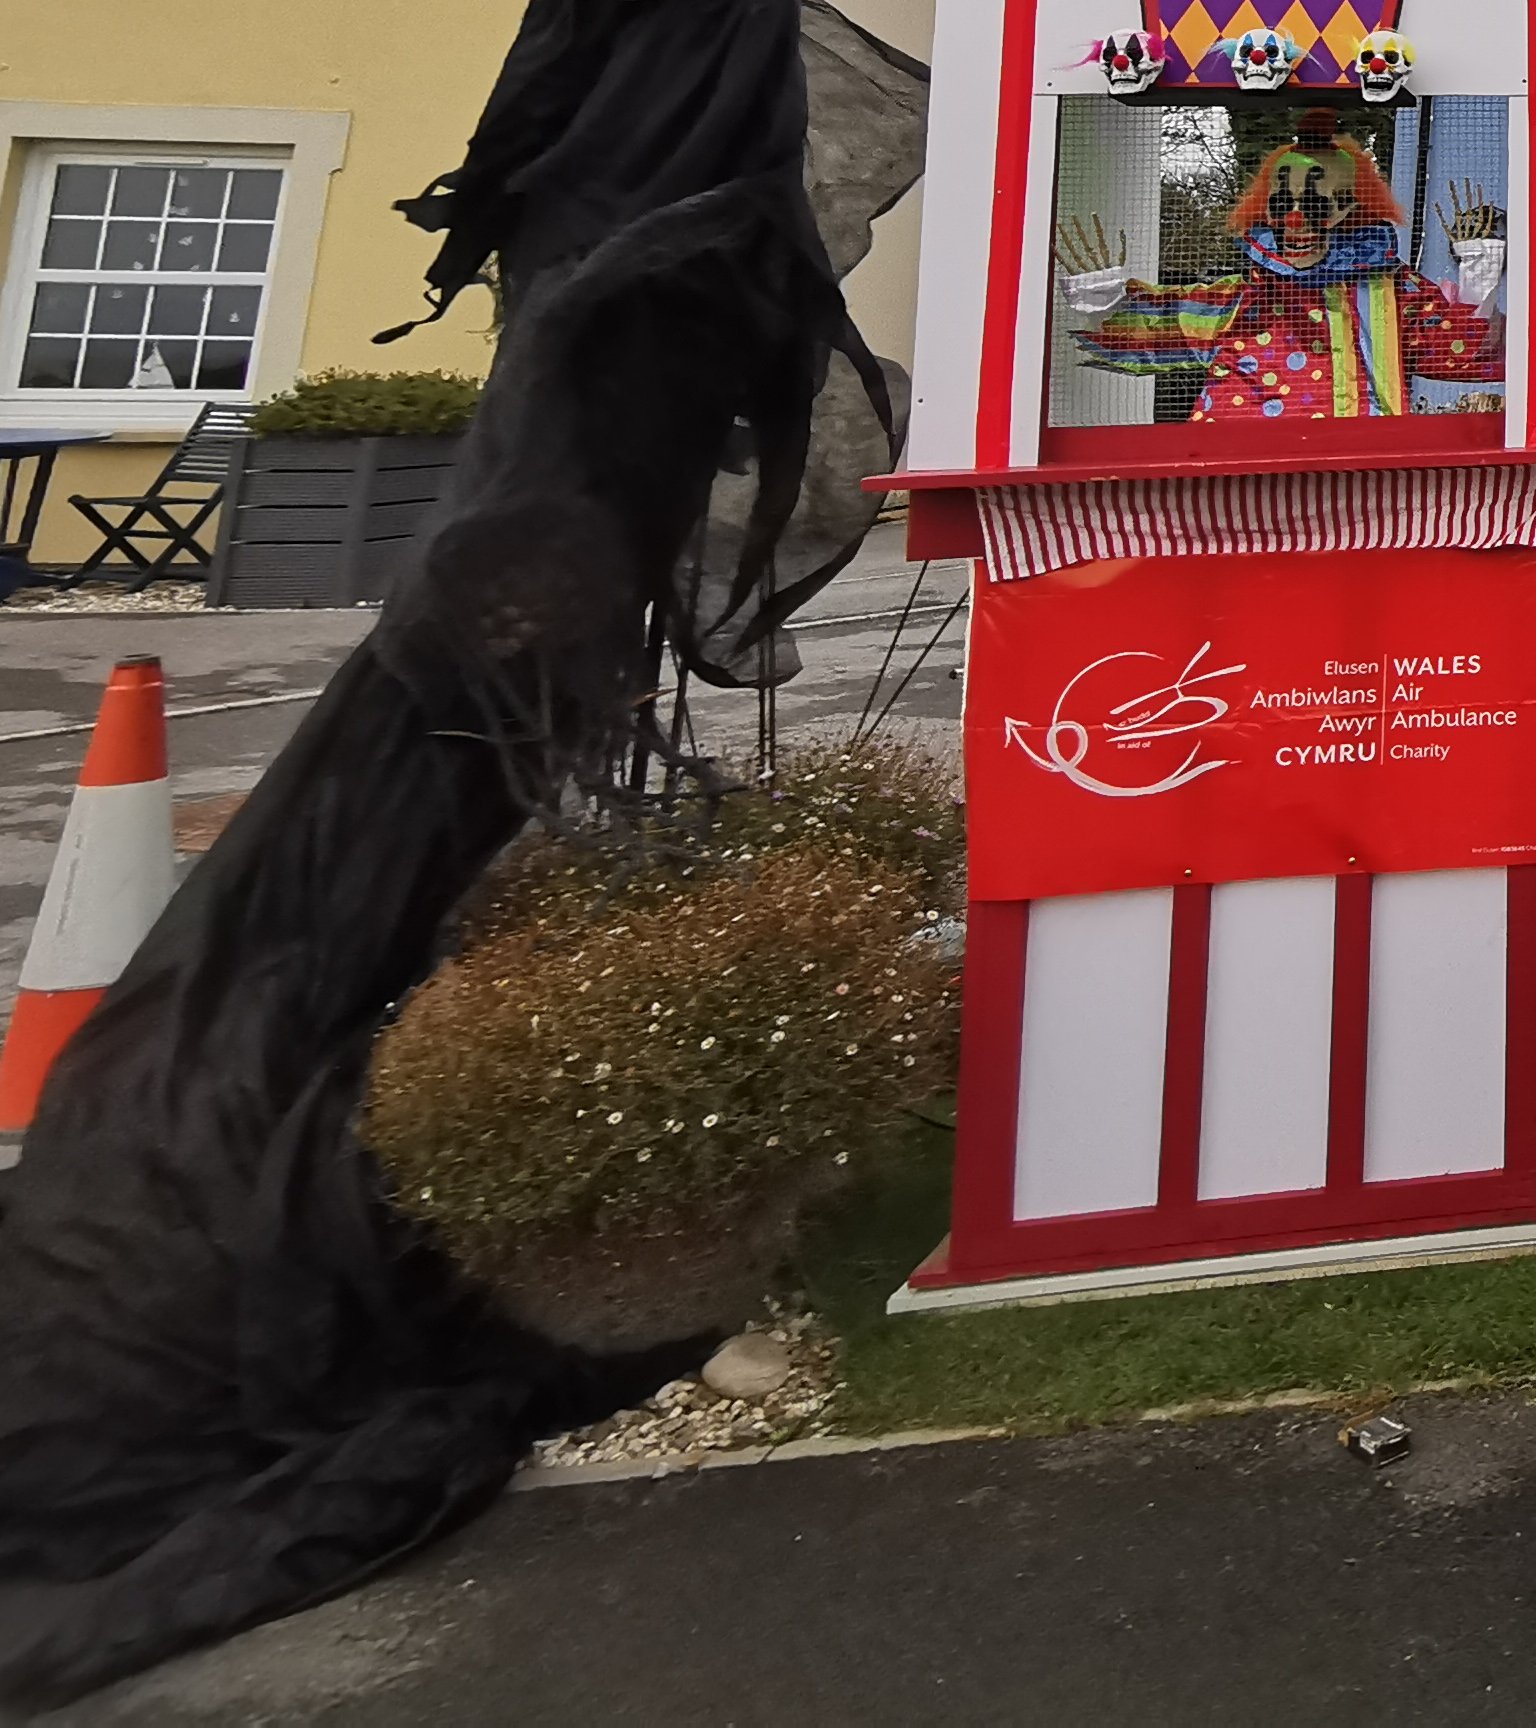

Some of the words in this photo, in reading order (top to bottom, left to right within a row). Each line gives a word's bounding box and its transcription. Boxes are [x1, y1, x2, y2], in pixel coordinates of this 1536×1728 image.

[1324, 660, 1379, 676] Elusen
[1393, 655, 1481, 677] WALES
[1250, 685, 1377, 709] Ambiwlans
[1392, 682, 1425, 703] Air
[1318, 713, 1377, 737] Awyr
[1390, 707, 1518, 730] Ambulance
[1275, 741, 1377, 767] CYMRU
[1390, 743, 1451, 762] Charity
